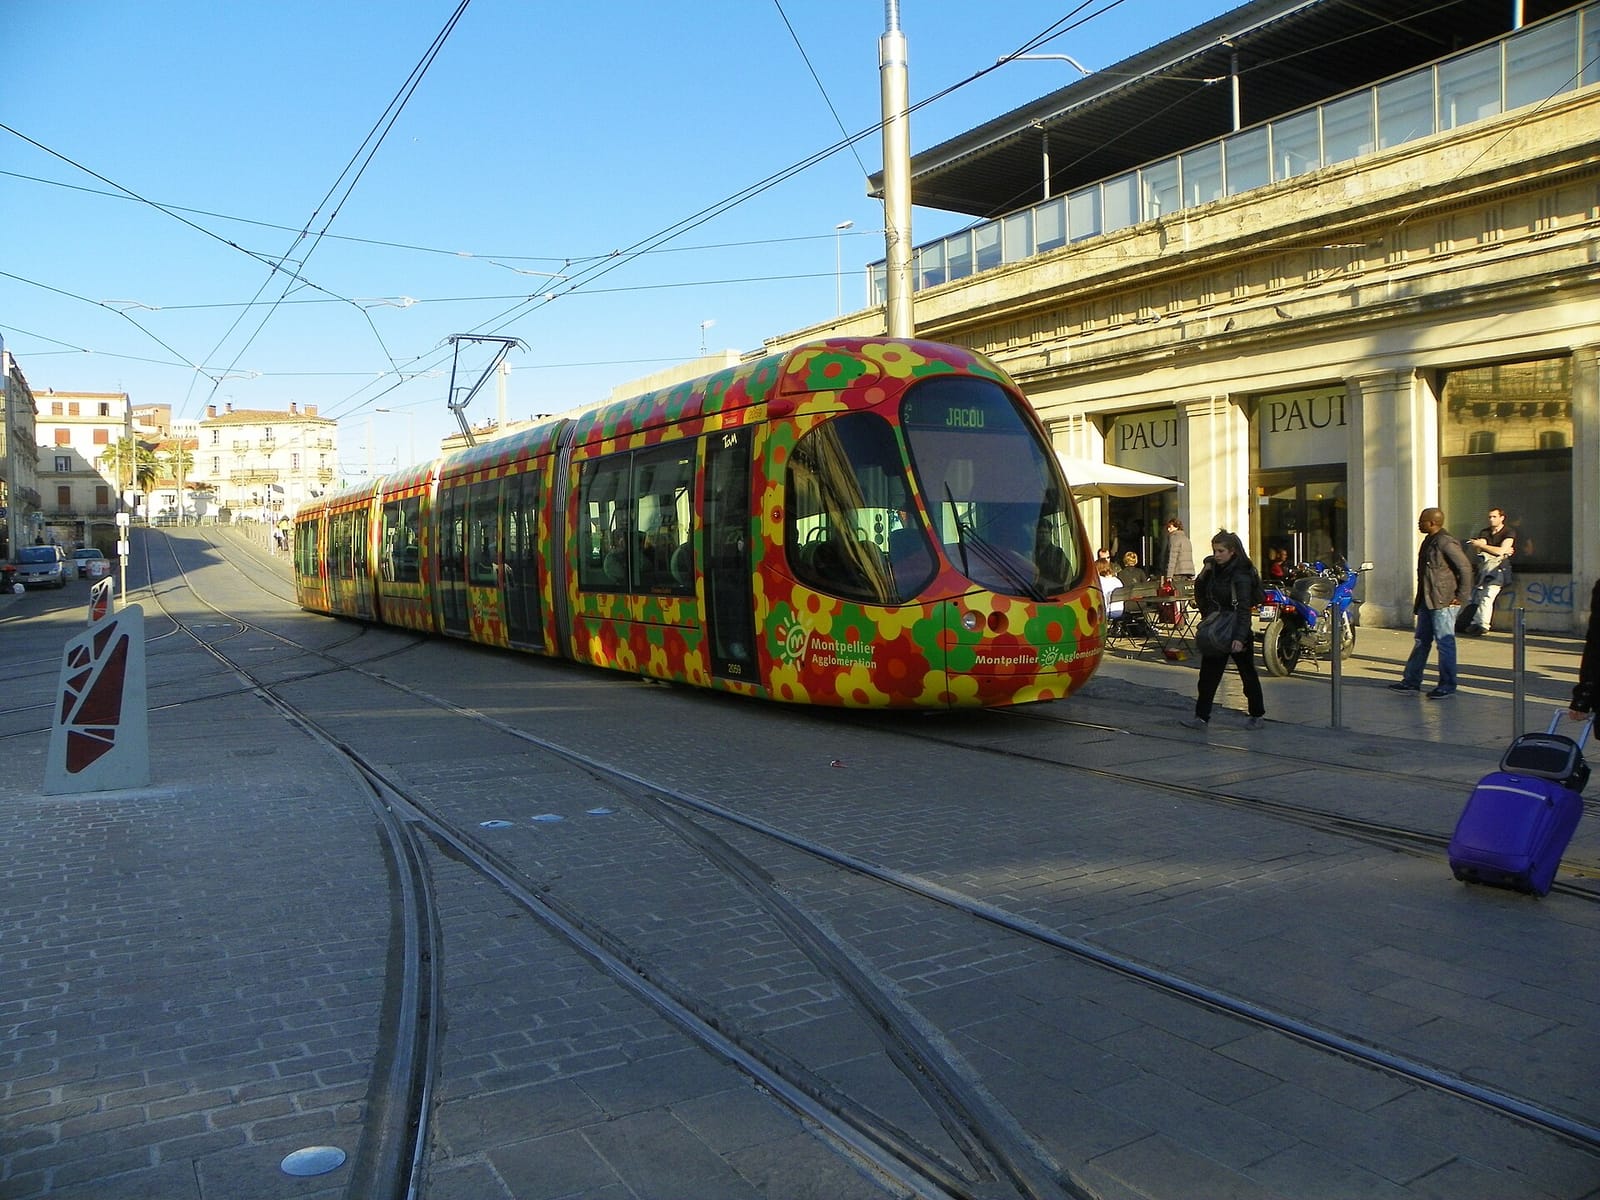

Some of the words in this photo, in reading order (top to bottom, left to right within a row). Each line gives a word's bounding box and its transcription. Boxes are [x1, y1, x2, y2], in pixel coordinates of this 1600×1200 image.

[946, 407, 984, 427] JACOU
[811, 638, 876, 655] Montpellier
[811, 653, 877, 669] Agglomération
[975, 655, 1039, 667] Montpellier
